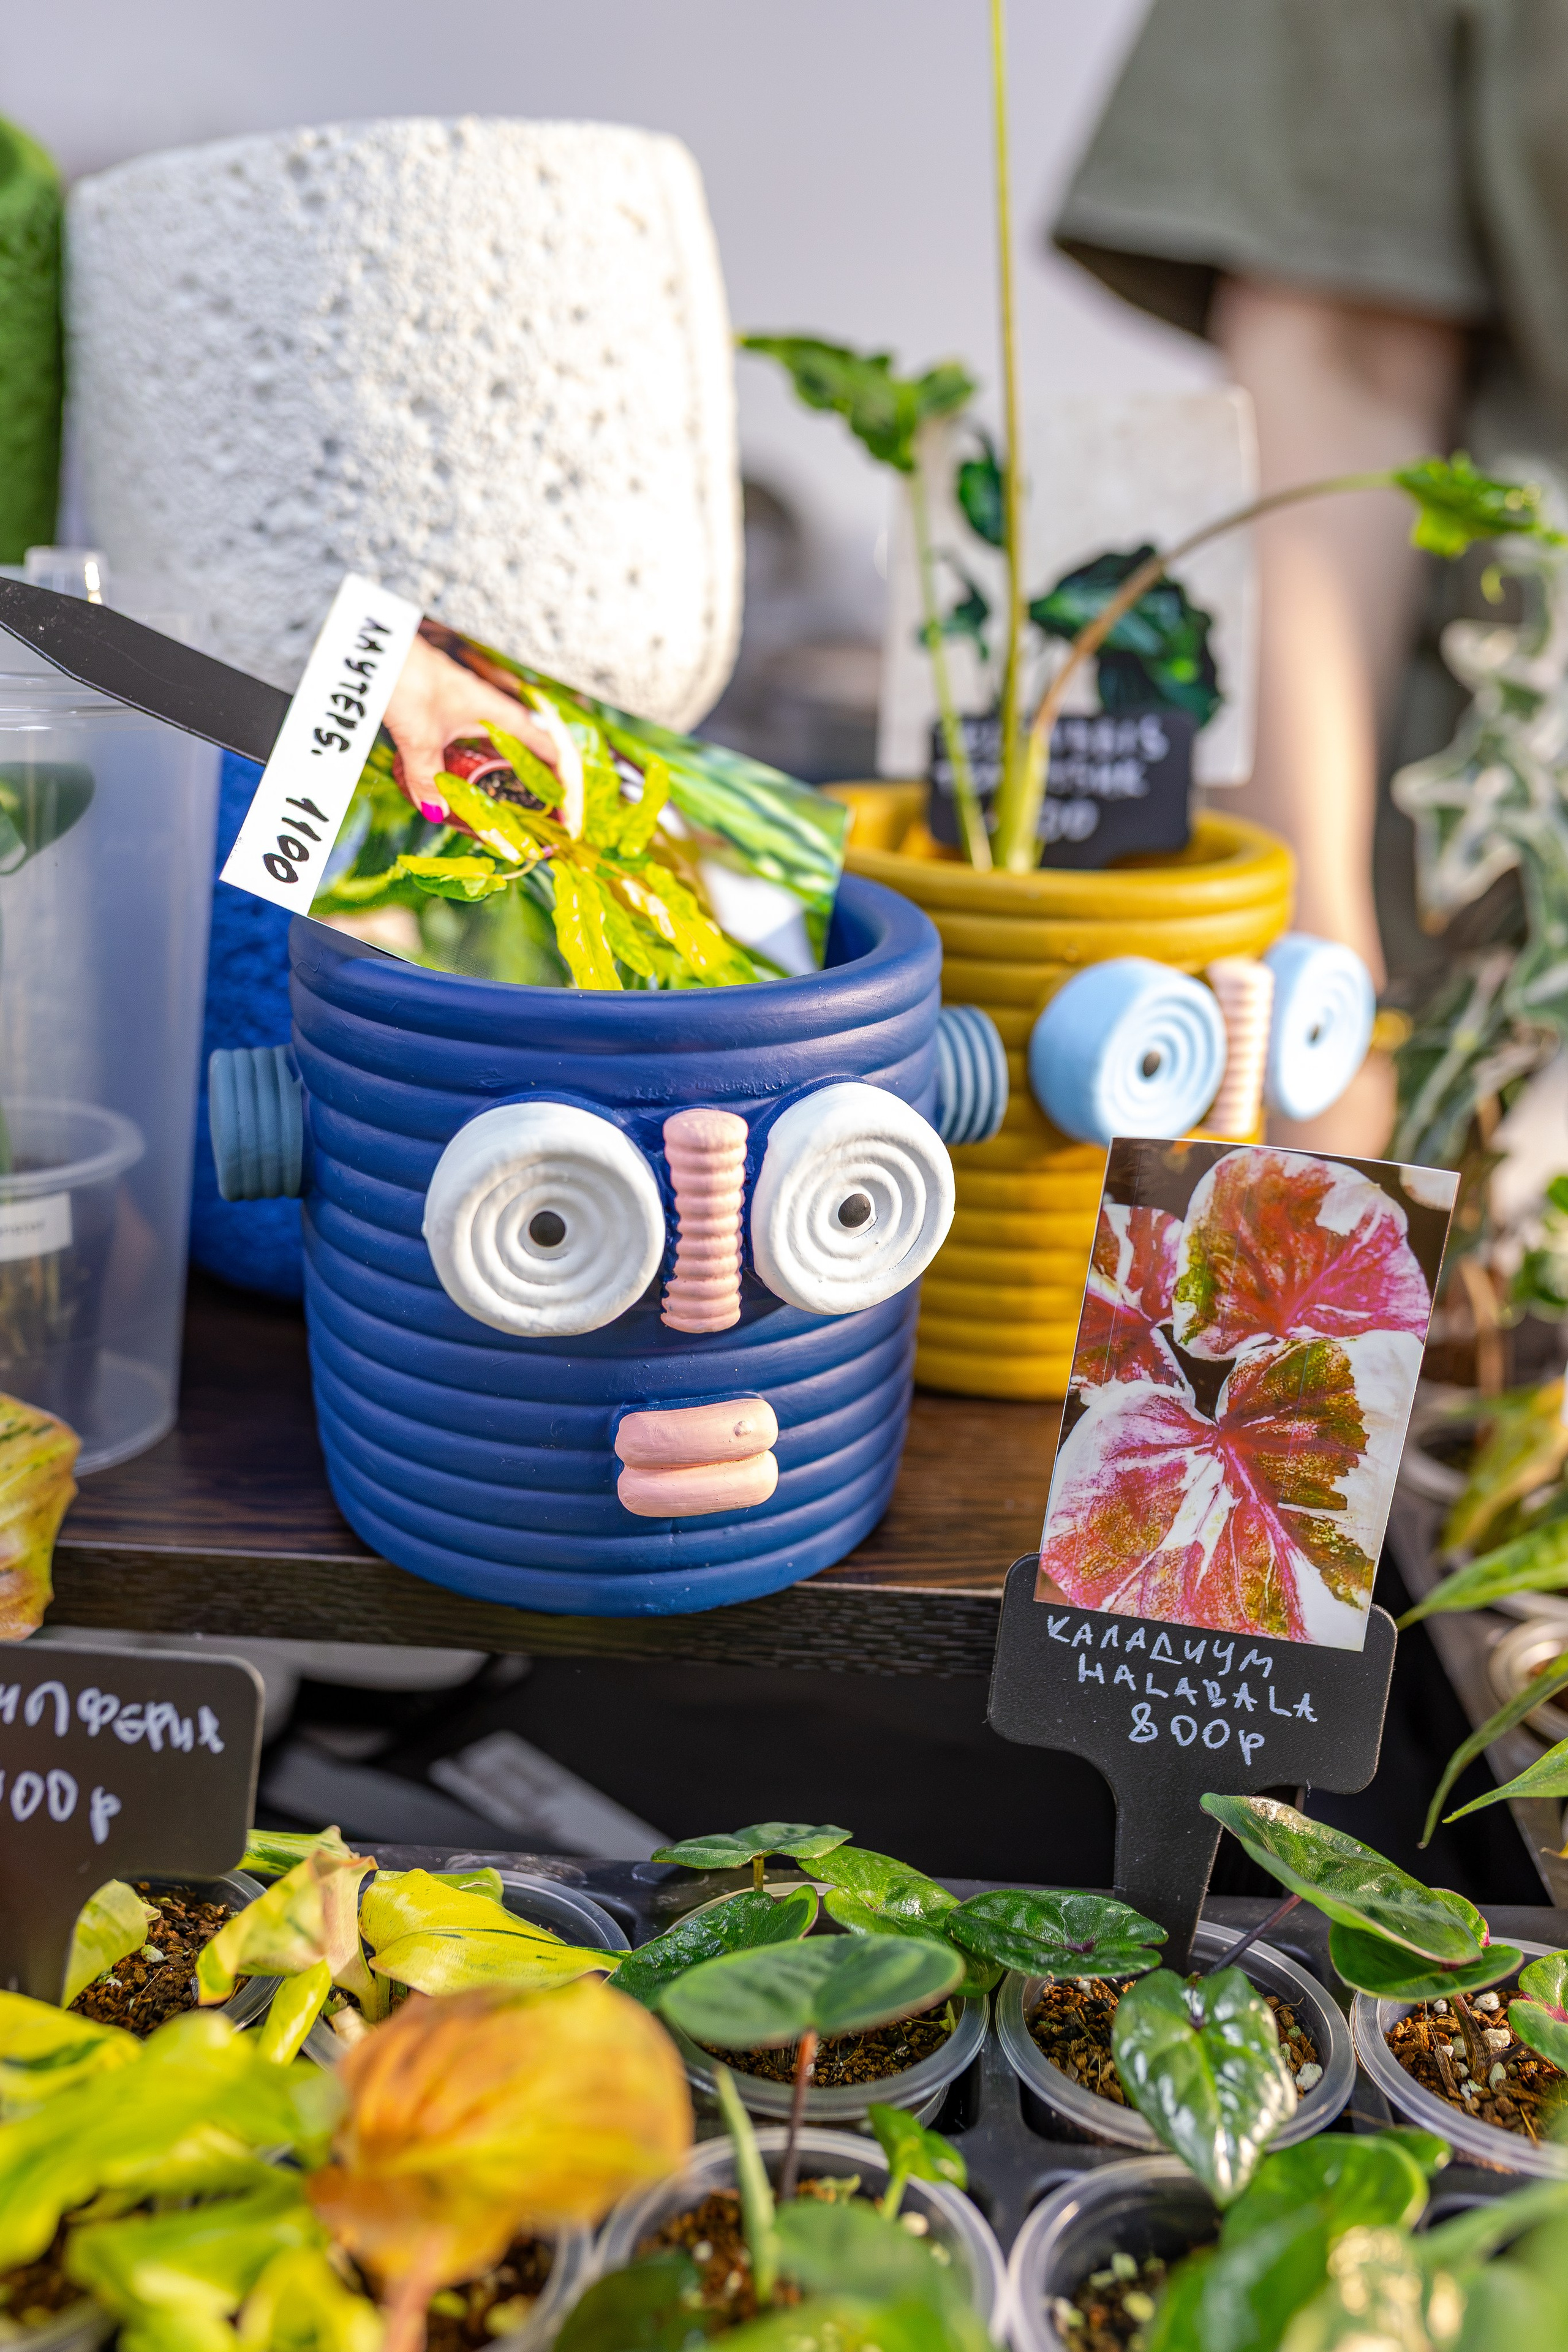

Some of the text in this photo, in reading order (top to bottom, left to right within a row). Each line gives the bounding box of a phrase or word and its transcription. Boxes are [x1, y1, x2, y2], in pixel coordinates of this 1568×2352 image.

[263, 797, 330, 884] 1100
[1046, 1615, 1273, 1678] КАЛАДИУМ
[1078, 1653, 1318, 1722] HALABALA
